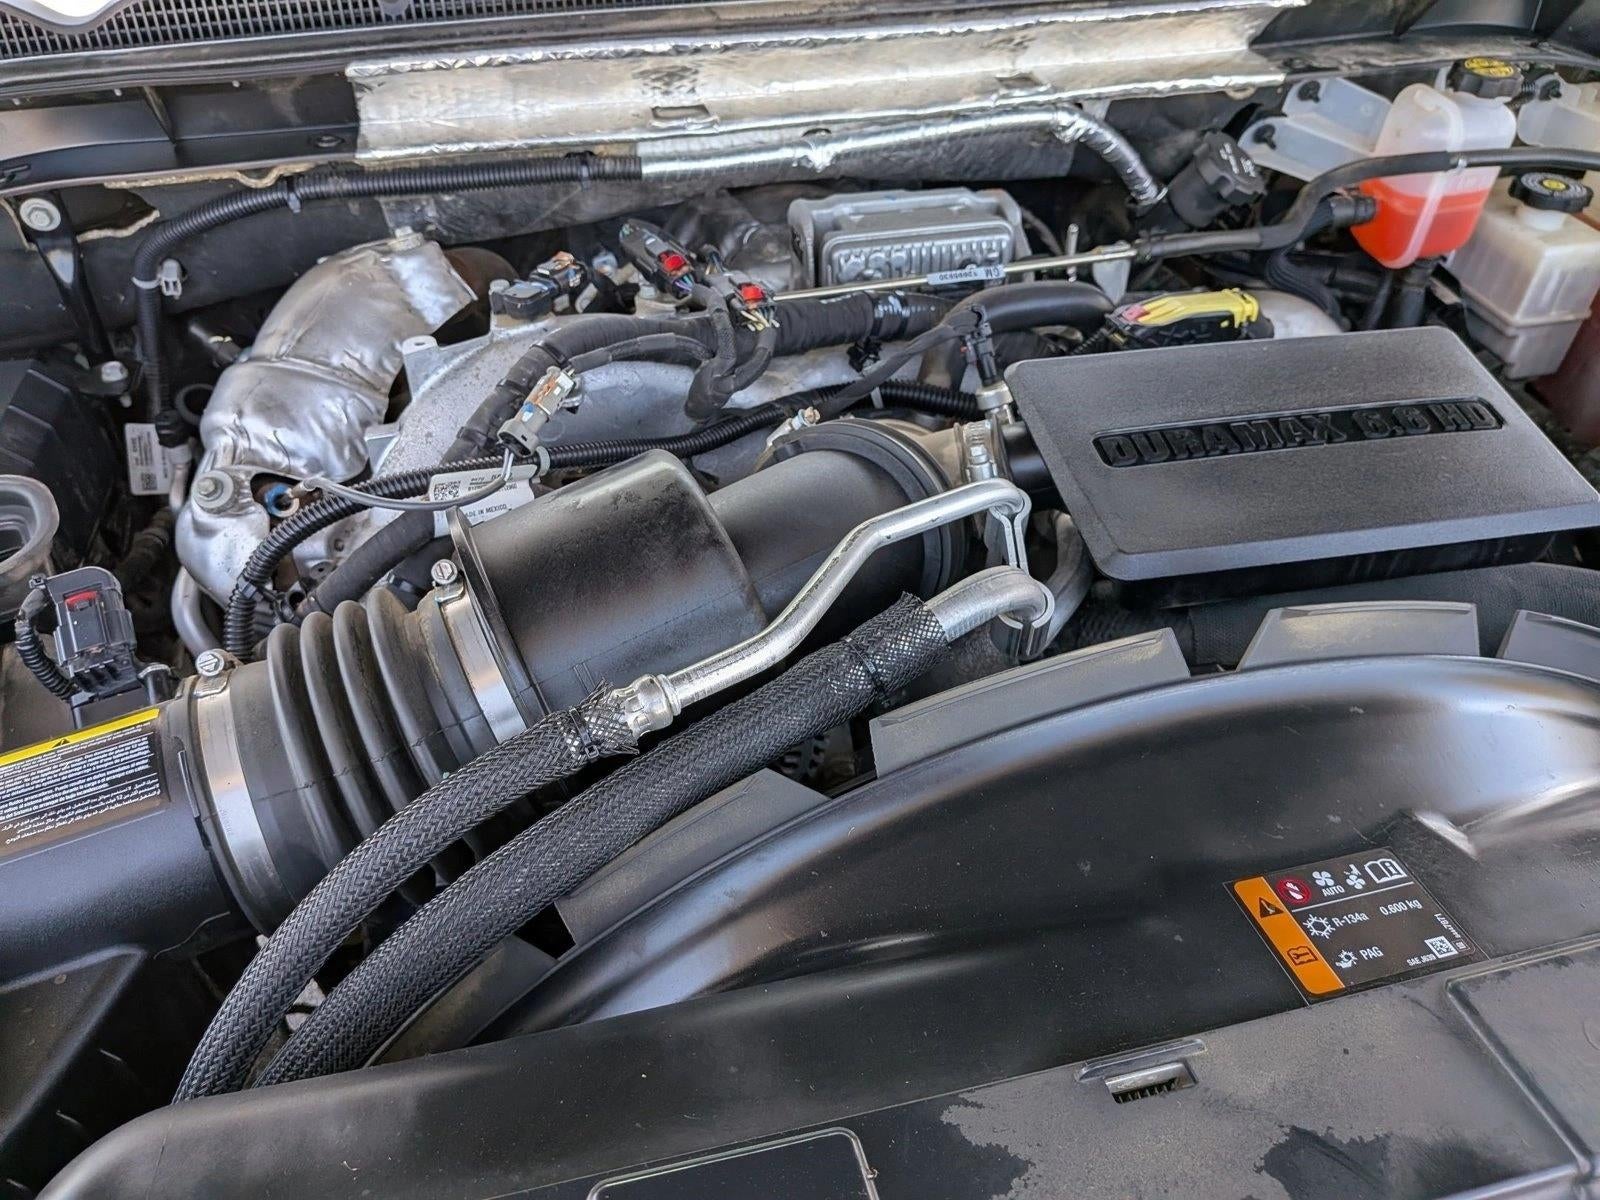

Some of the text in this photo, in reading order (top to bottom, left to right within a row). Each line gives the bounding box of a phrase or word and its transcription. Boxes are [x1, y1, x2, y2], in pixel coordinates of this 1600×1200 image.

[1103, 401, 1498, 467] DURAMAX 6.6 HD
[1322, 885, 1345, 897] AUTO
[1331, 898, 1423, 927] R-134a 0.600 kg
[1361, 947, 1384, 961] PAG
